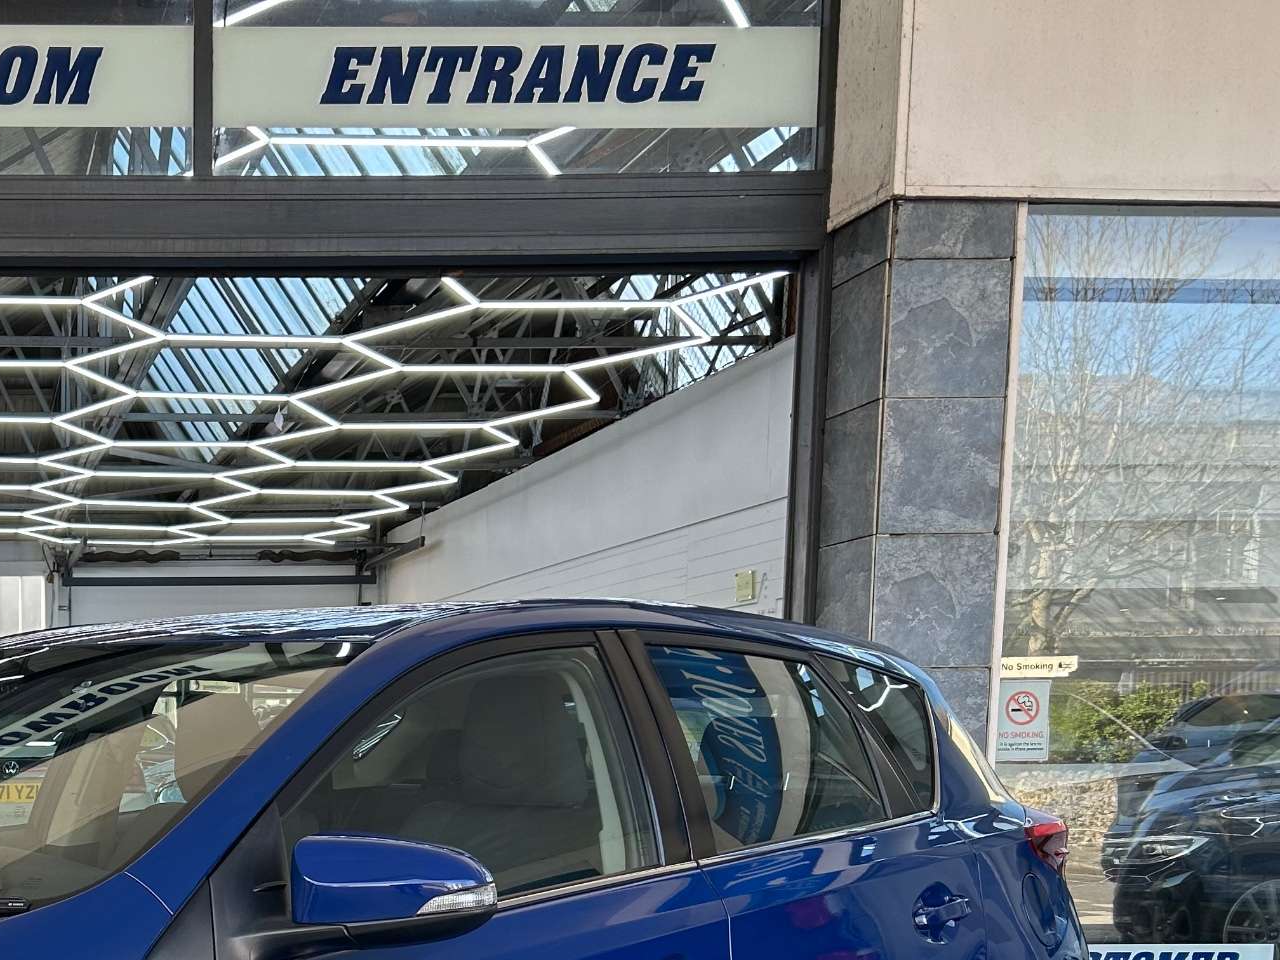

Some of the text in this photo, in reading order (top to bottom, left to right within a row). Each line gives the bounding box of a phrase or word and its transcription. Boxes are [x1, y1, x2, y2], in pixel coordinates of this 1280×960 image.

[320, 42, 717, 105] ENTRANCE
[1001, 663, 1054, 673] No Smoking
[15, 784, 40, 799] YZ
